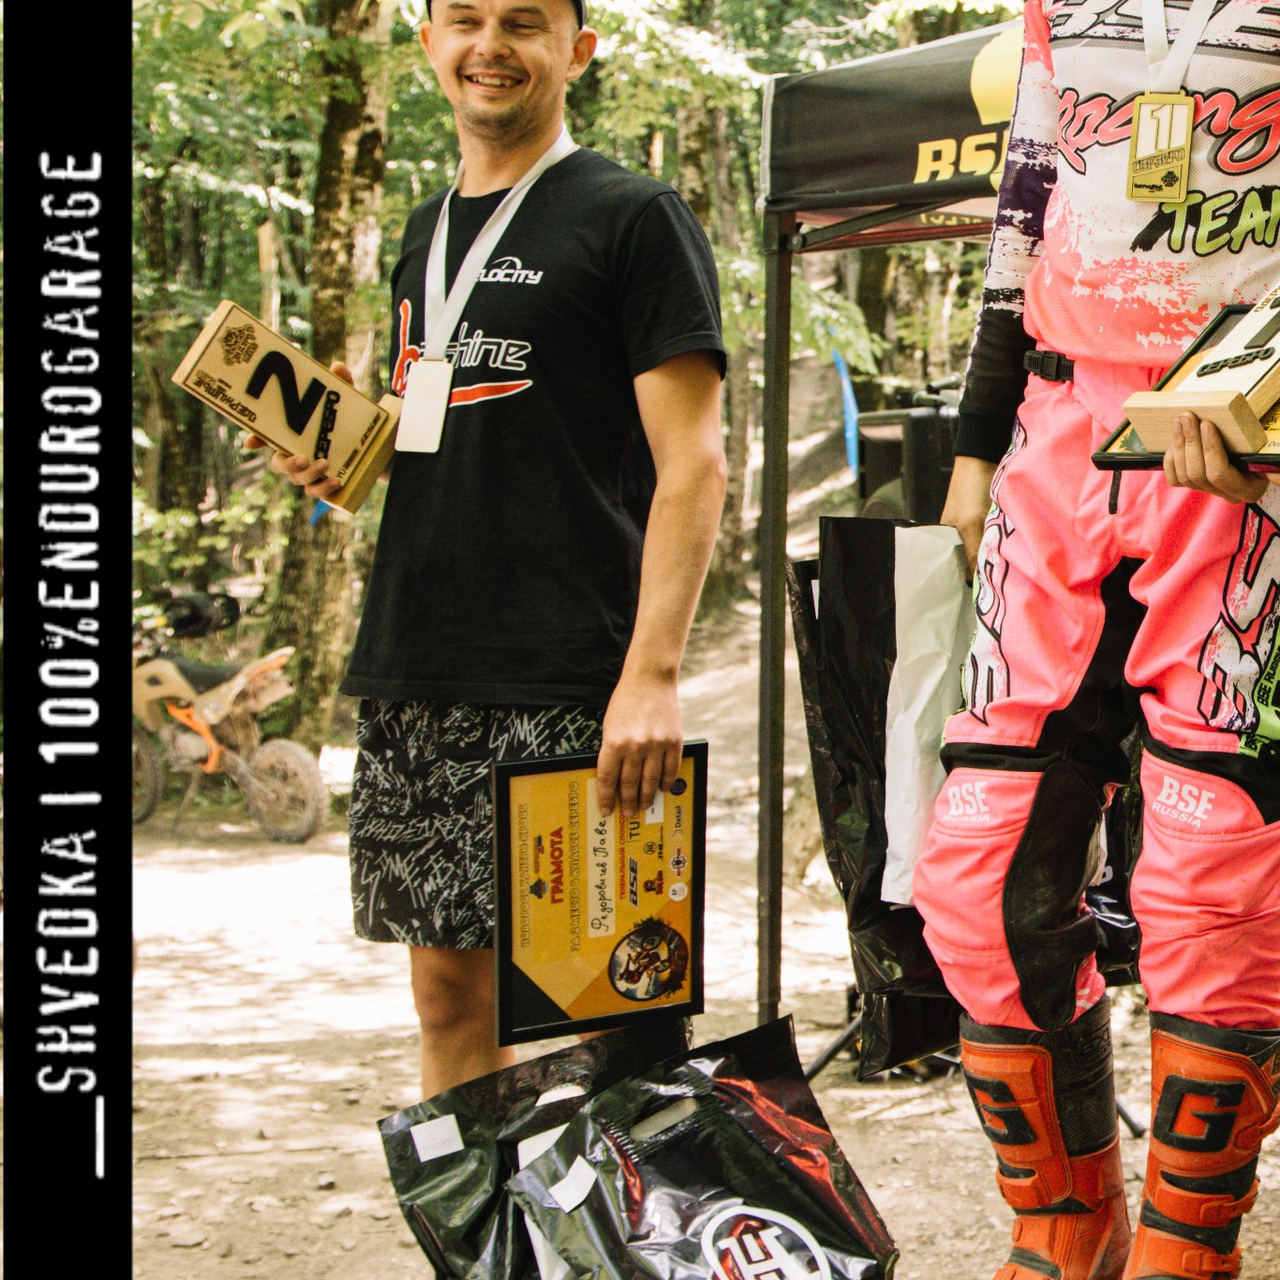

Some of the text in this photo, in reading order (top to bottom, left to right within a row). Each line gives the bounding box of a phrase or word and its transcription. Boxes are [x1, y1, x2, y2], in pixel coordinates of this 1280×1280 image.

[477, 268, 544, 285] LOCITY
[1196, 346, 1276, 378] СЕРЕБРО
[245, 350, 327, 436] 2
[1256, 680, 1271, 706] BSE
[569, 782, 579, 829] СЕРЕБРО
[674, 806, 683, 828] Detail
[947, 781, 990, 816] BSE
[1152, 802, 1202, 829] RUSSIA
[1156, 775, 1216, 820] BSE
[592, 813, 608, 858] Паве
[629, 821, 640, 840] TU
[550, 827, 564, 904] ГРАМОТА
[618, 808, 626, 900] ГЕНЕРАЛЬНЫЙ СПОНСО
[629, 856, 639, 909] BSE
